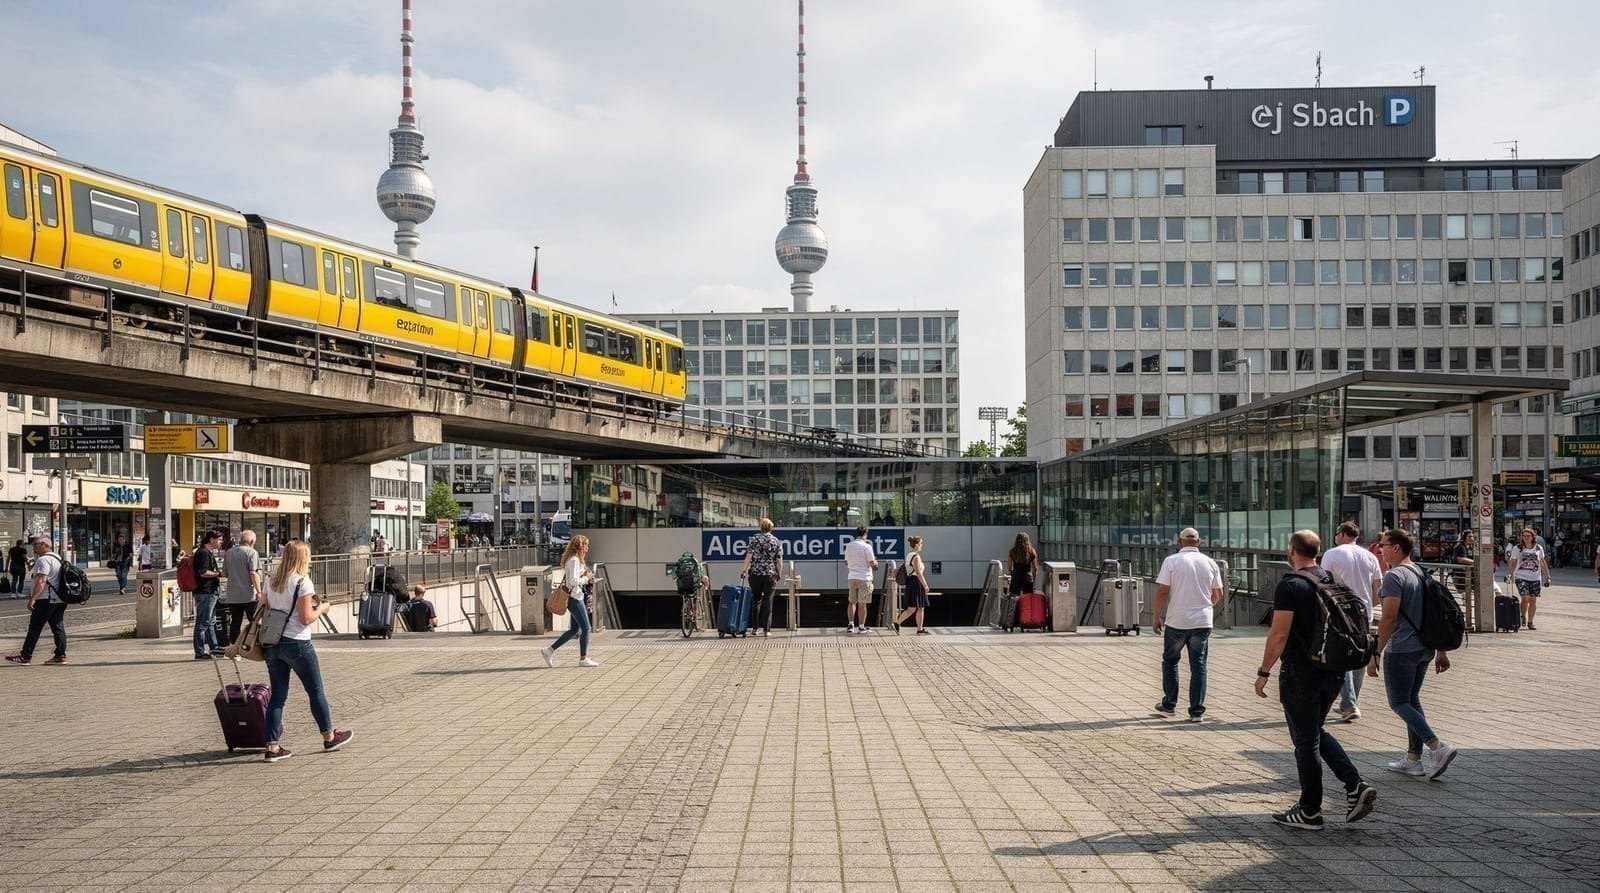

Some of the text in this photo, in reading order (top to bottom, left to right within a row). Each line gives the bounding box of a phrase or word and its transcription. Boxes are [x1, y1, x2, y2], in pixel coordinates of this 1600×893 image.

[1292, 100, 1374, 127] Sbach
[1390, 98, 1410, 124] P
[706, 534, 898, 556] Alender Ptz
